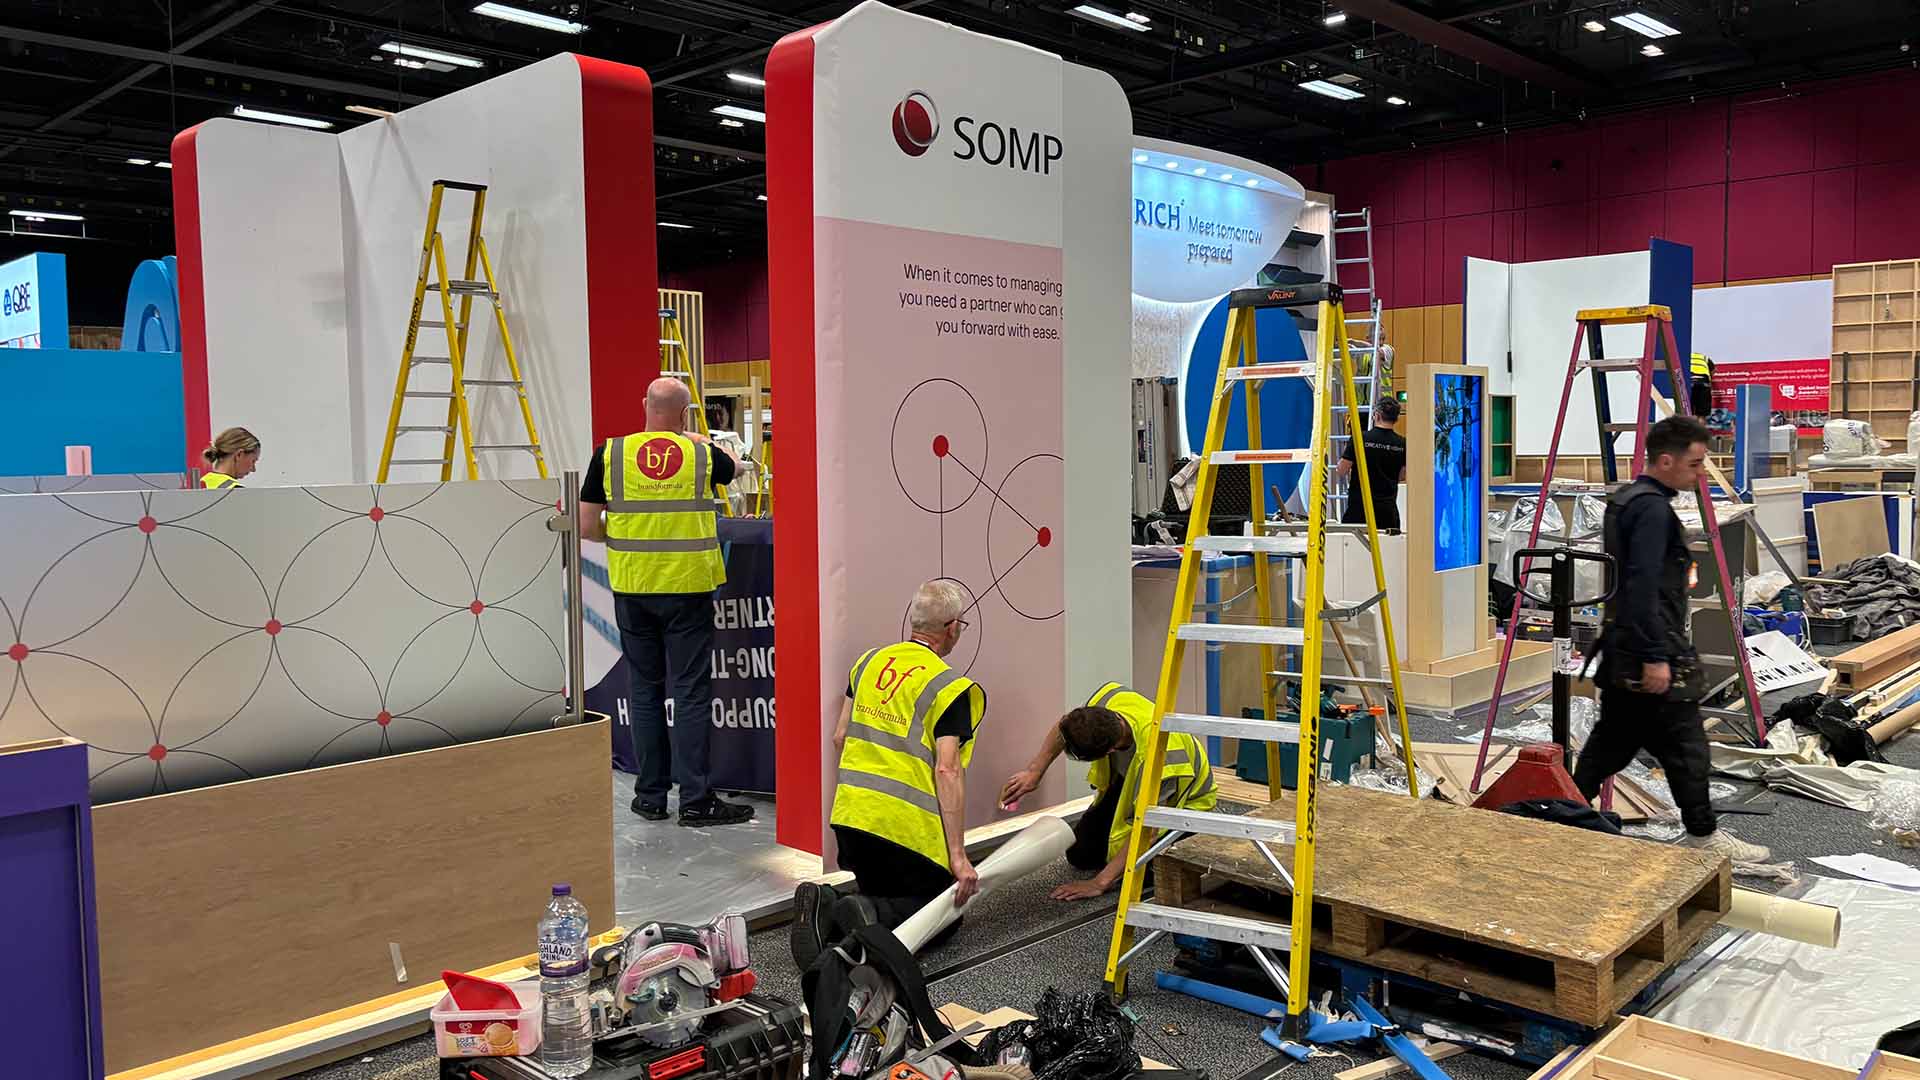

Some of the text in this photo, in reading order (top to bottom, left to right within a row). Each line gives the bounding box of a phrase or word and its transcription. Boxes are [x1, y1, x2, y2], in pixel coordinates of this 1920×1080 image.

[953, 116, 1064, 175] SOMP
[1134, 198, 1262, 245] RICH Meet tomorrow
[1187, 243, 1233, 264] prepared
[903, 263, 1063, 297] When it comes to managing
[13, 281, 31, 314] QBE
[899, 292, 923, 308] you
[925, 294, 957, 309] need
[959, 297, 967, 310] a
[970, 298, 1012, 313] partner
[1013, 300, 1036, 315] who
[1038, 304, 1058, 317] can
[936, 320, 1060, 340] you forward with ease.
[644, 444, 676, 476] bf
[713, 596, 775, 630] RTNER
[710, 646, 775, 679] ONG-T
[875, 656, 926, 705] bf
[711, 697, 776, 729] SUPPO
[538, 942, 572, 957] GHLAND
